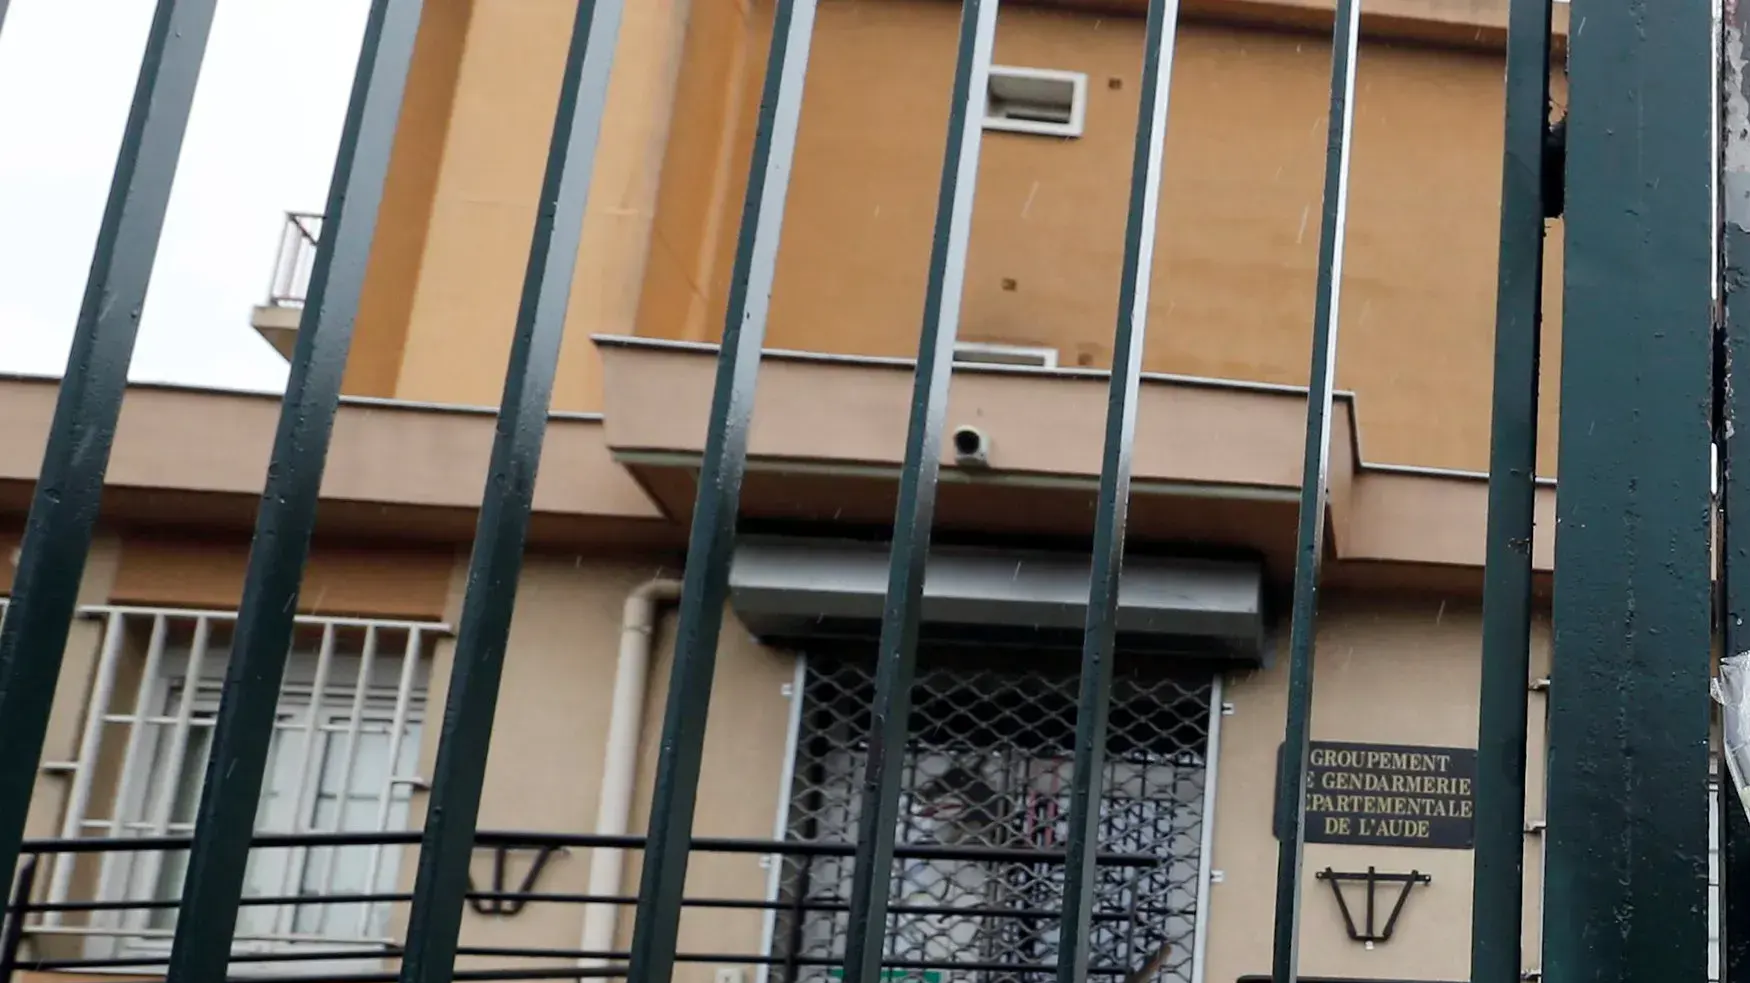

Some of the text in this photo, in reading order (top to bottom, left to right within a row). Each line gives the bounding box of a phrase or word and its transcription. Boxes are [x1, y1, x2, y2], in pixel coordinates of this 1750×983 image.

[1310, 748, 1450, 772] GROUPEMENT
[1322, 772, 1471, 796] GENDARMERIE
[1306, 793, 1473, 818] PARTEMENTALE
[1324, 817, 1430, 838] DE L'AUDE
